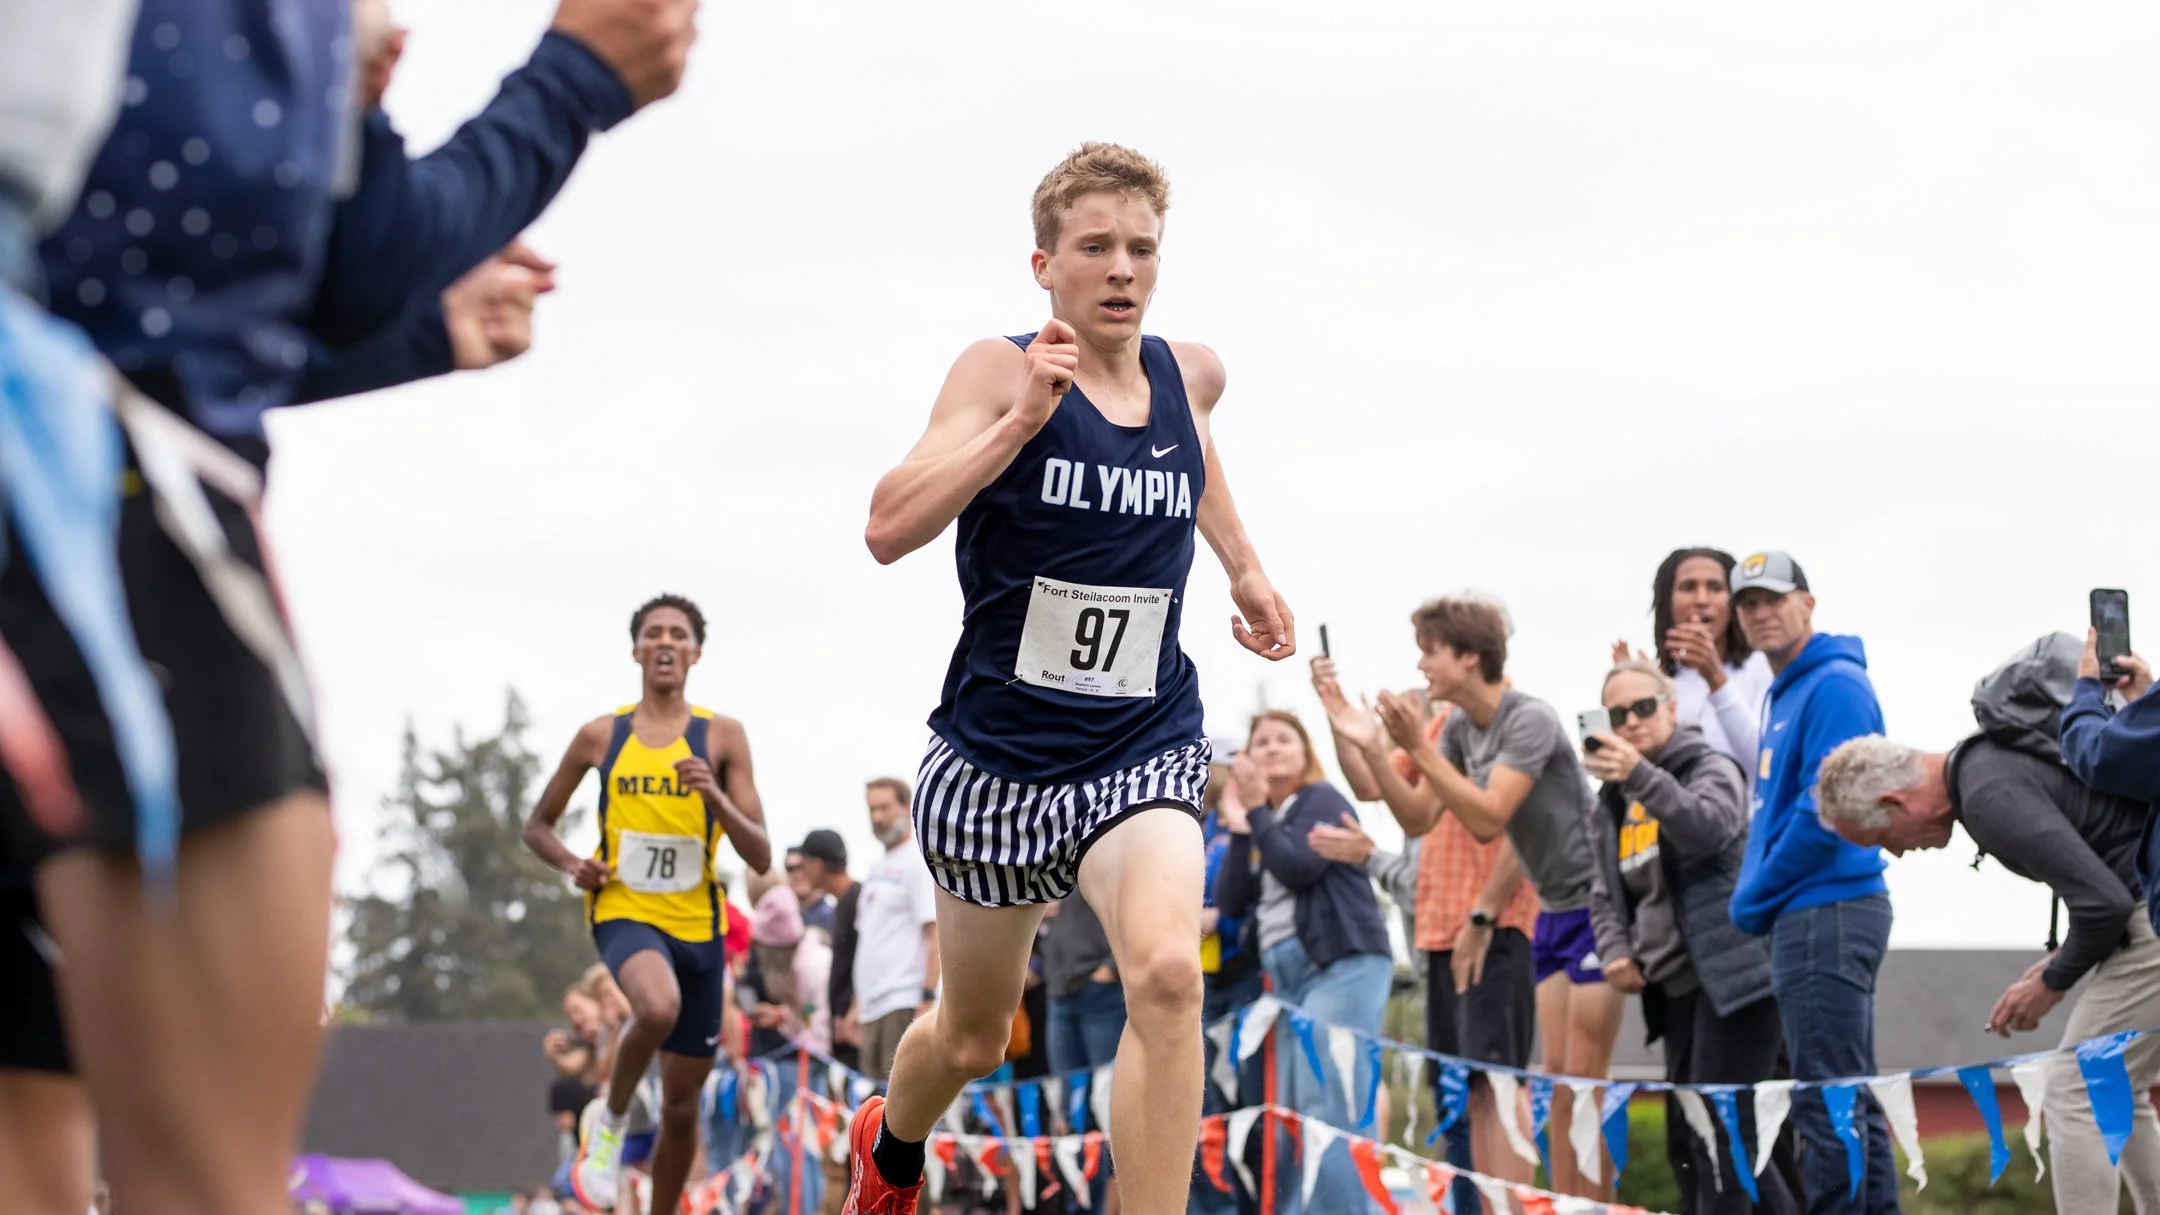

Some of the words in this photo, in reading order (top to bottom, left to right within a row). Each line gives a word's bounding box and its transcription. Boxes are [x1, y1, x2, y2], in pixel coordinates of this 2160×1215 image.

[1040, 457, 1192, 519] OLYMPIA
[1043, 584, 1068, 598] Fort
[1071, 590, 1131, 603] Steilacoom
[1133, 593, 1160, 604] Invite
[1069, 607, 1130, 672] 97
[1041, 670, 1066, 682] Rout
[646, 846, 678, 879] 78
